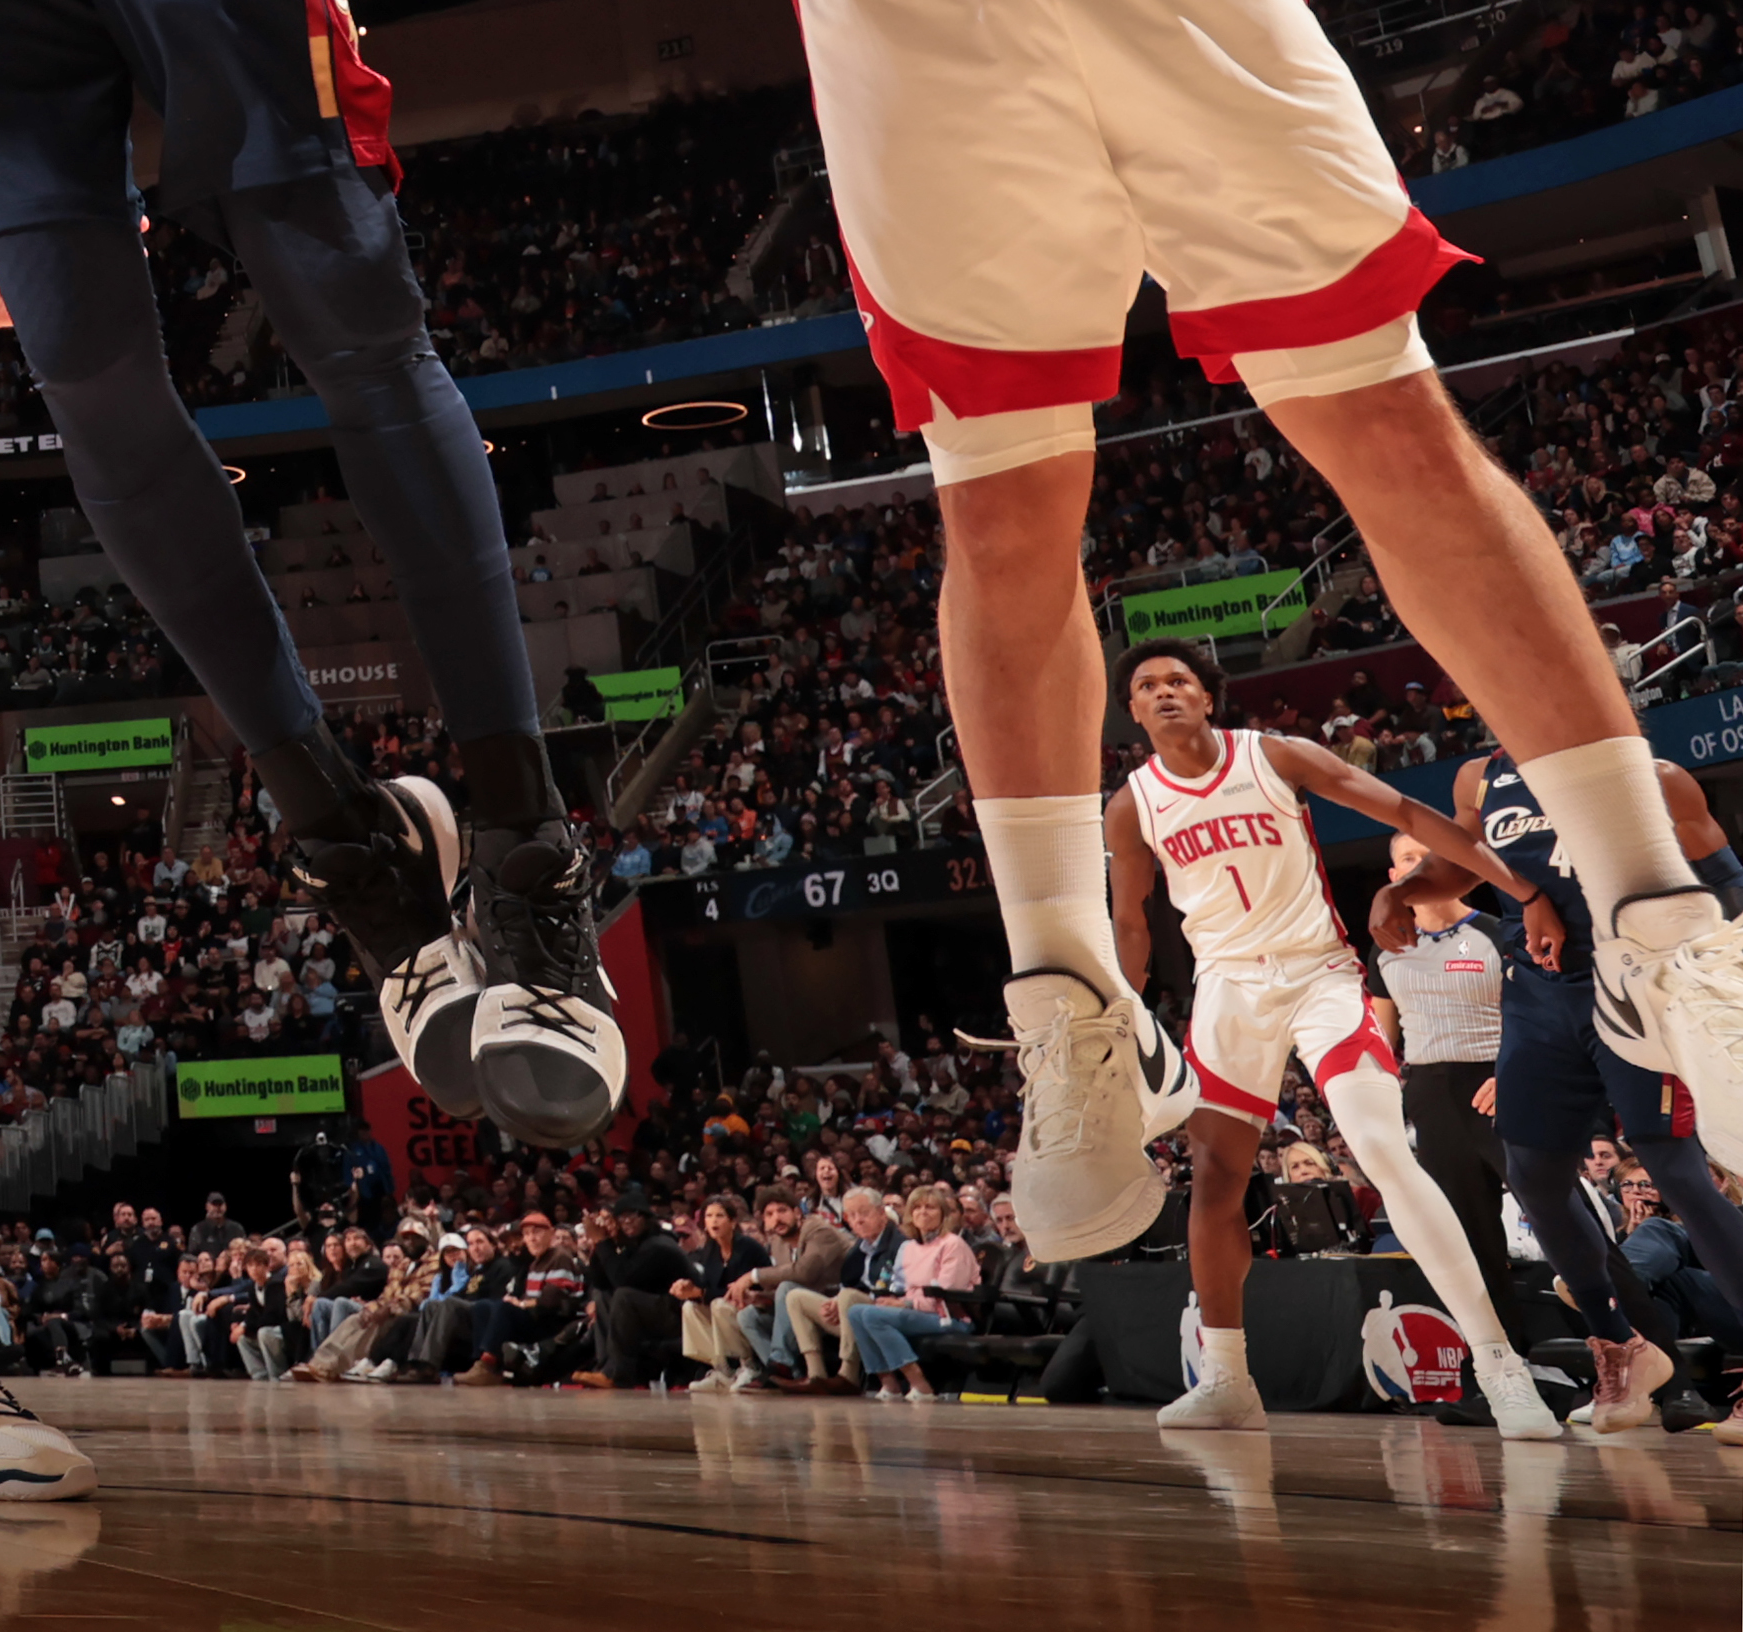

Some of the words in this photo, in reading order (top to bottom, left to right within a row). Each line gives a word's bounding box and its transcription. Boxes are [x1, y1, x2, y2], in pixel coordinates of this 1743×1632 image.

[1374, 38, 1404, 58] 219
[1154, 598, 1253, 628] Huntington
[1255, 589, 1304, 611] Bank
[50, 737, 129, 758] Huntington
[133, 735, 171, 751] Bank
[1690, 732, 1717, 760] OF
[1161, 811, 1283, 870] ROCKETS
[696, 881, 719, 894] FLS
[803, 870, 846, 908] 67
[866, 869, 900, 895] 3Q
[1225, 865, 1252, 913] 1
[704, 897, 719, 922] 4
[1445, 960, 1483, 973] Emirates
[205, 1078, 293, 1100] Huntington
[297, 1074, 340, 1093] Bank
[406, 1134, 482, 1167] GEE
